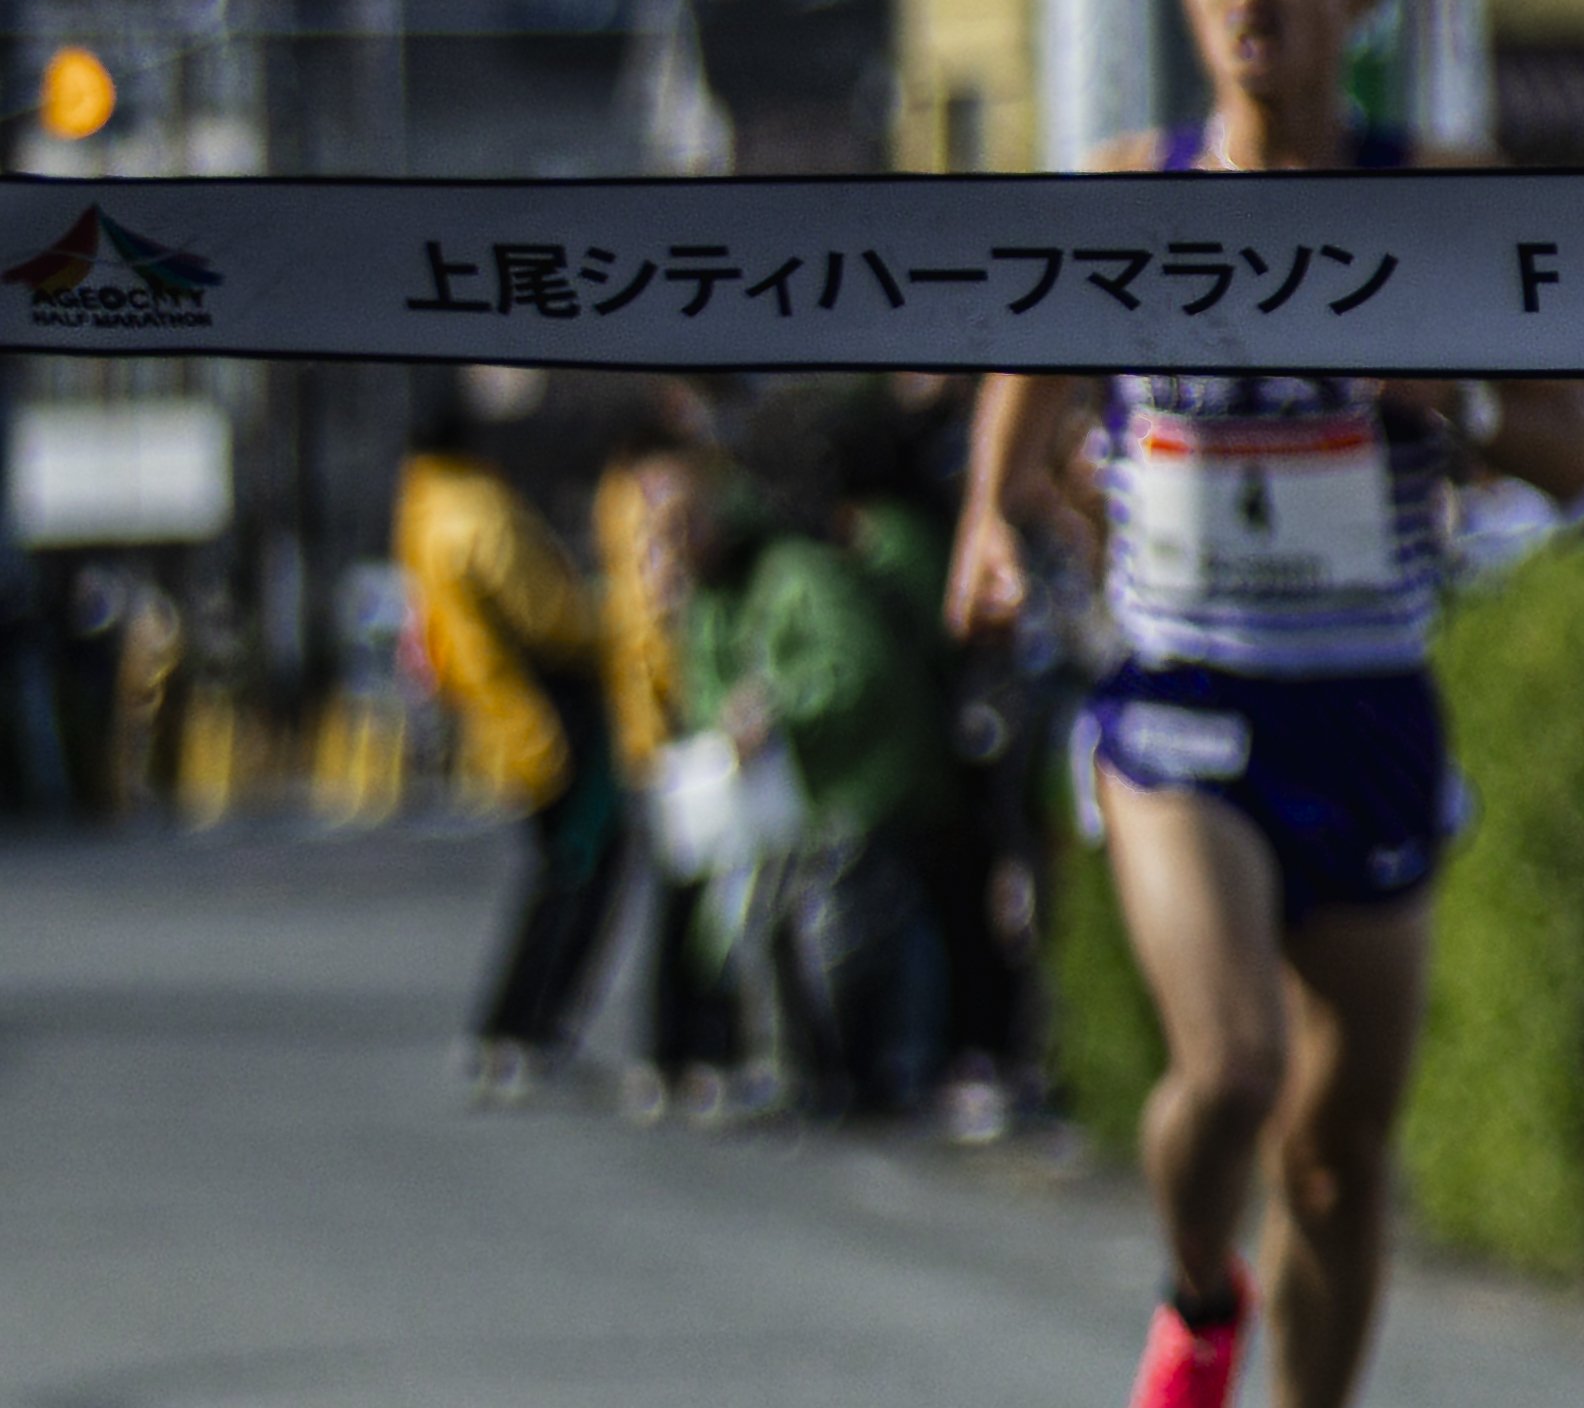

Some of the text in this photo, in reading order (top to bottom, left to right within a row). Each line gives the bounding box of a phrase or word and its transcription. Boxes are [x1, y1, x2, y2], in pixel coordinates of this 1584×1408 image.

[407, 240, 1398, 319] 上尾シティハーフマラソン
